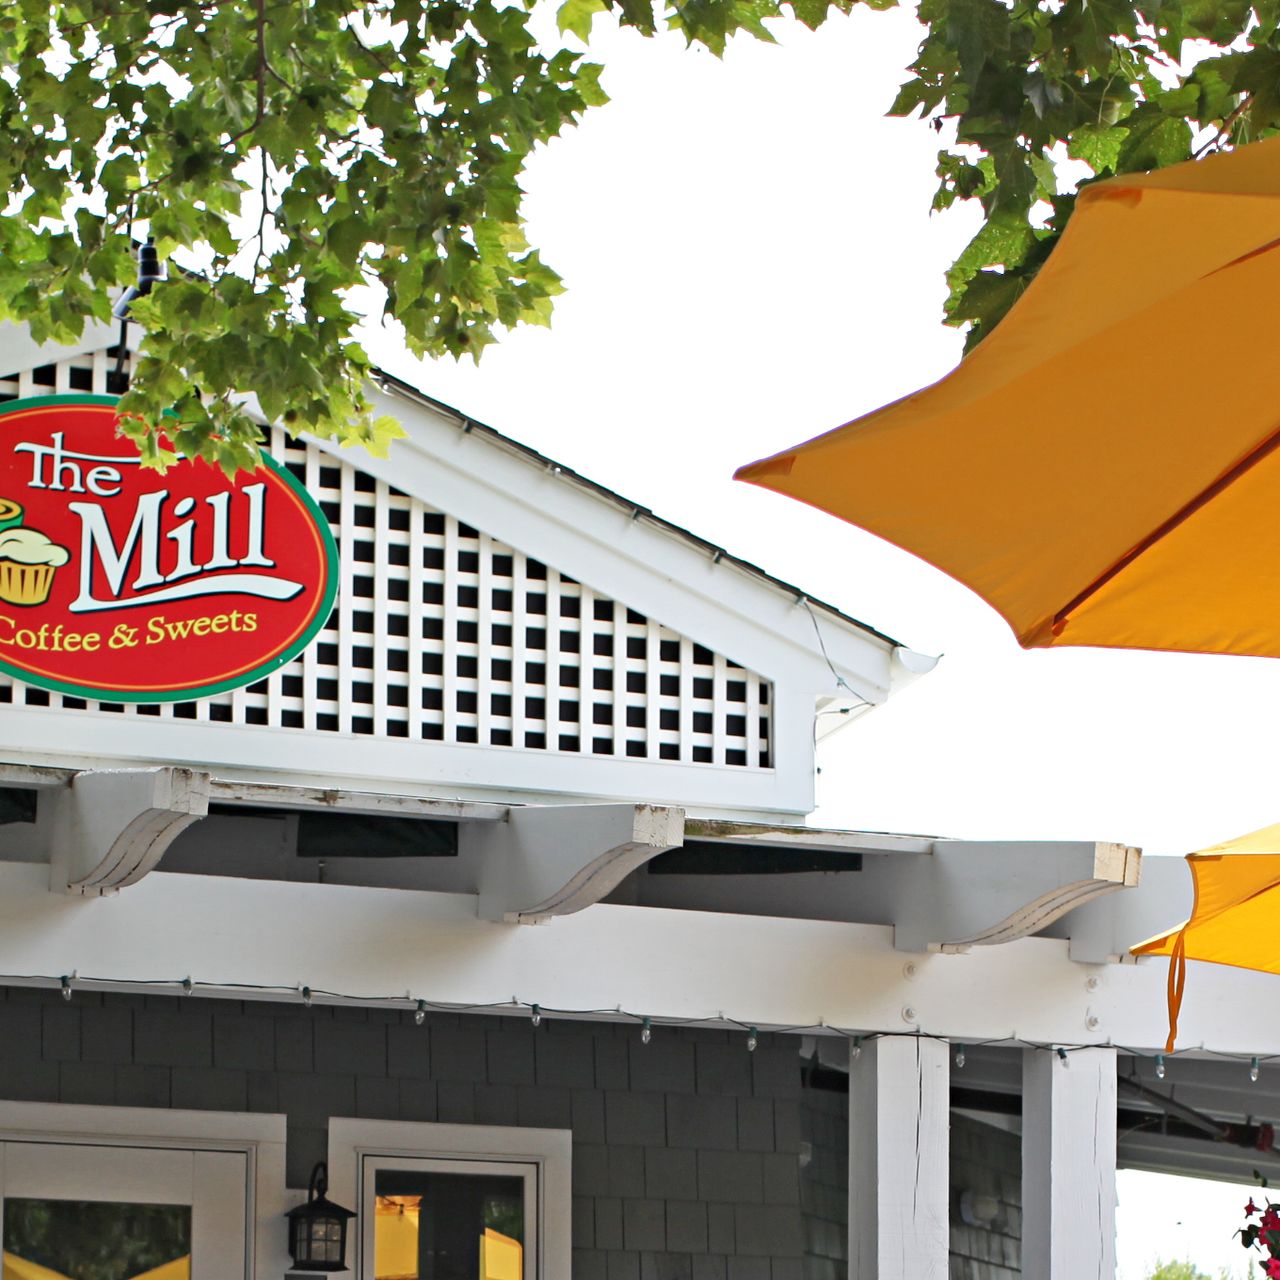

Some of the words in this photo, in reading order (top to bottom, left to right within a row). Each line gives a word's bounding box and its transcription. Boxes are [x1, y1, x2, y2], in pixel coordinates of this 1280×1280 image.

[14, 432, 186, 497] The
[68, 483, 306, 613] Mill
[108, 624, 138, 649] &
[145, 608, 258, 645] Sweets
